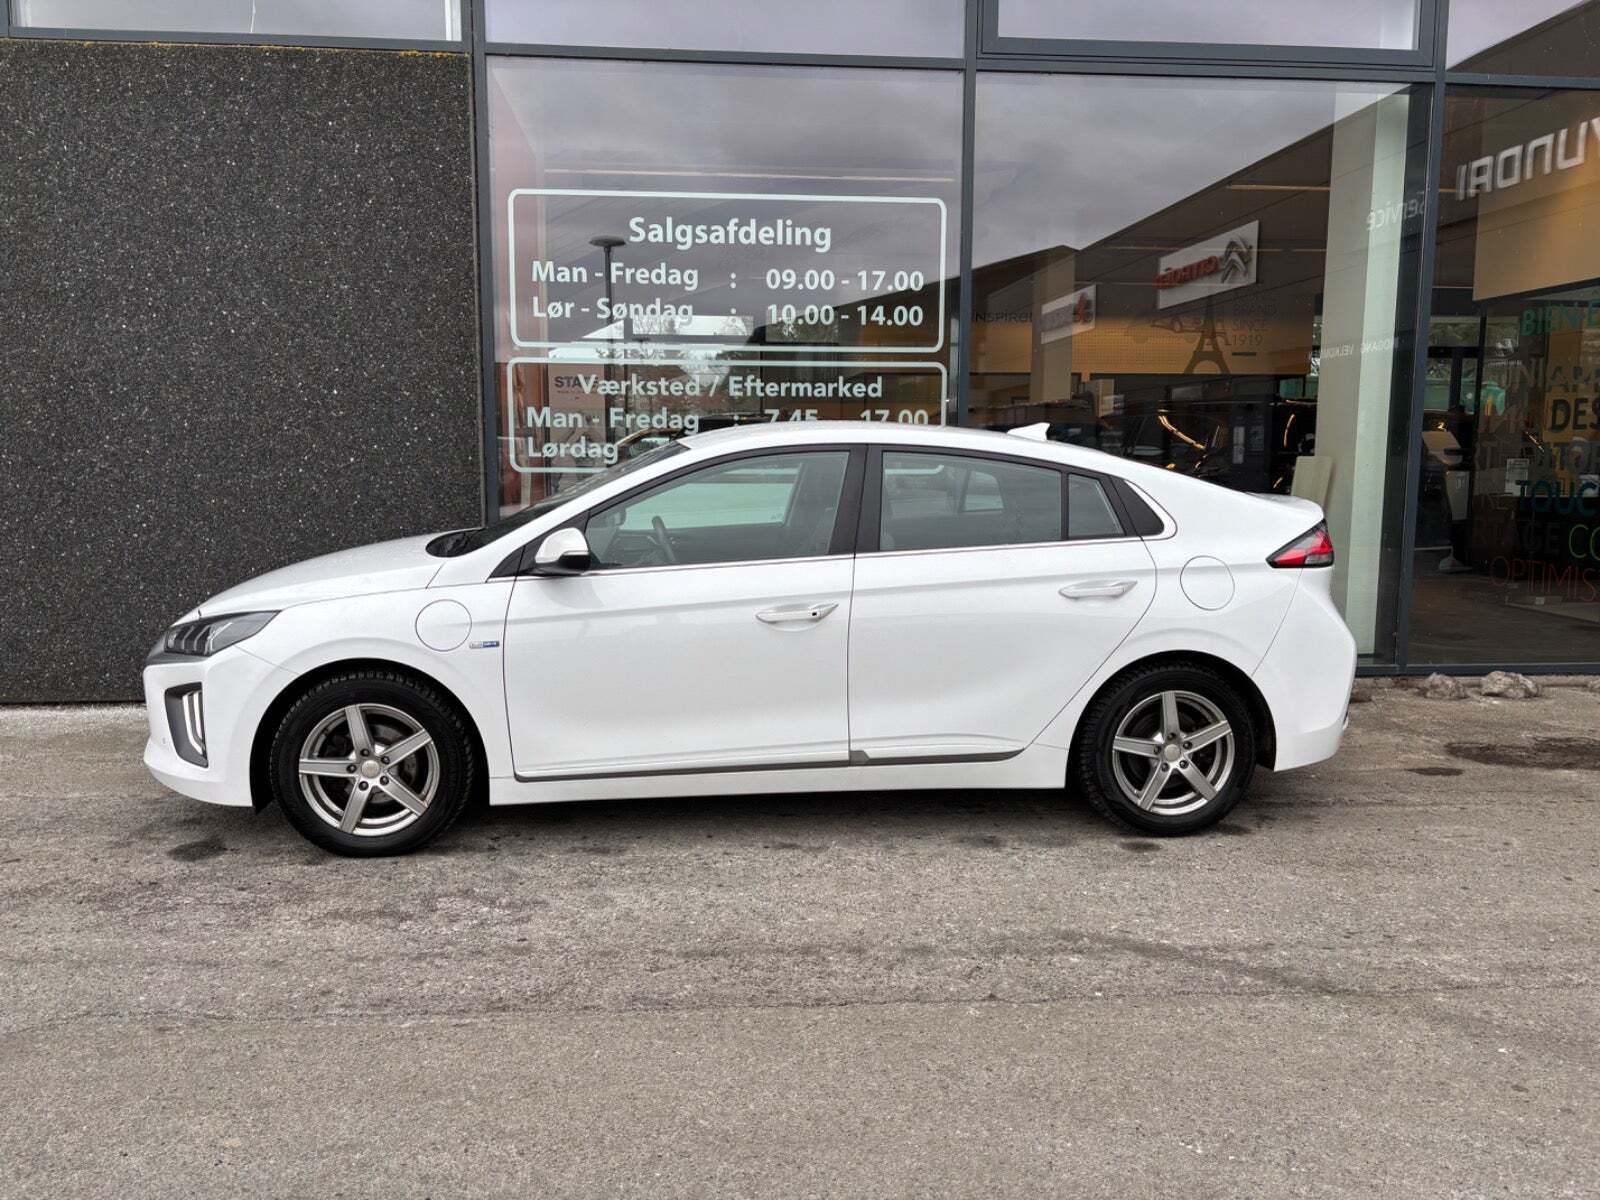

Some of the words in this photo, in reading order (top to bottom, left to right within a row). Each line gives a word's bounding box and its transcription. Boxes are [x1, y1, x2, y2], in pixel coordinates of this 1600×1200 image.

[628, 216, 832, 252] Salgsafdeling
[531, 261, 587, 284] Man
[609, 263, 699, 291] Fredag
[765, 269, 836, 291] 09.00
[857, 270, 924, 291] 17.00
[531, 297, 576, 320] Lør
[596, 297, 694, 325] Søndag
[767, 304, 835, 326] 10.00
[857, 305, 924, 327] 14.00
[577, 373, 701, 398] Værksted
[728, 376, 883, 399] Eftermarked
[526, 407, 581, 429] Man
[609, 408, 700, 433] Fredag
[860, 409, 929, 425] 1700
[527, 436, 619, 465] Lørdag
